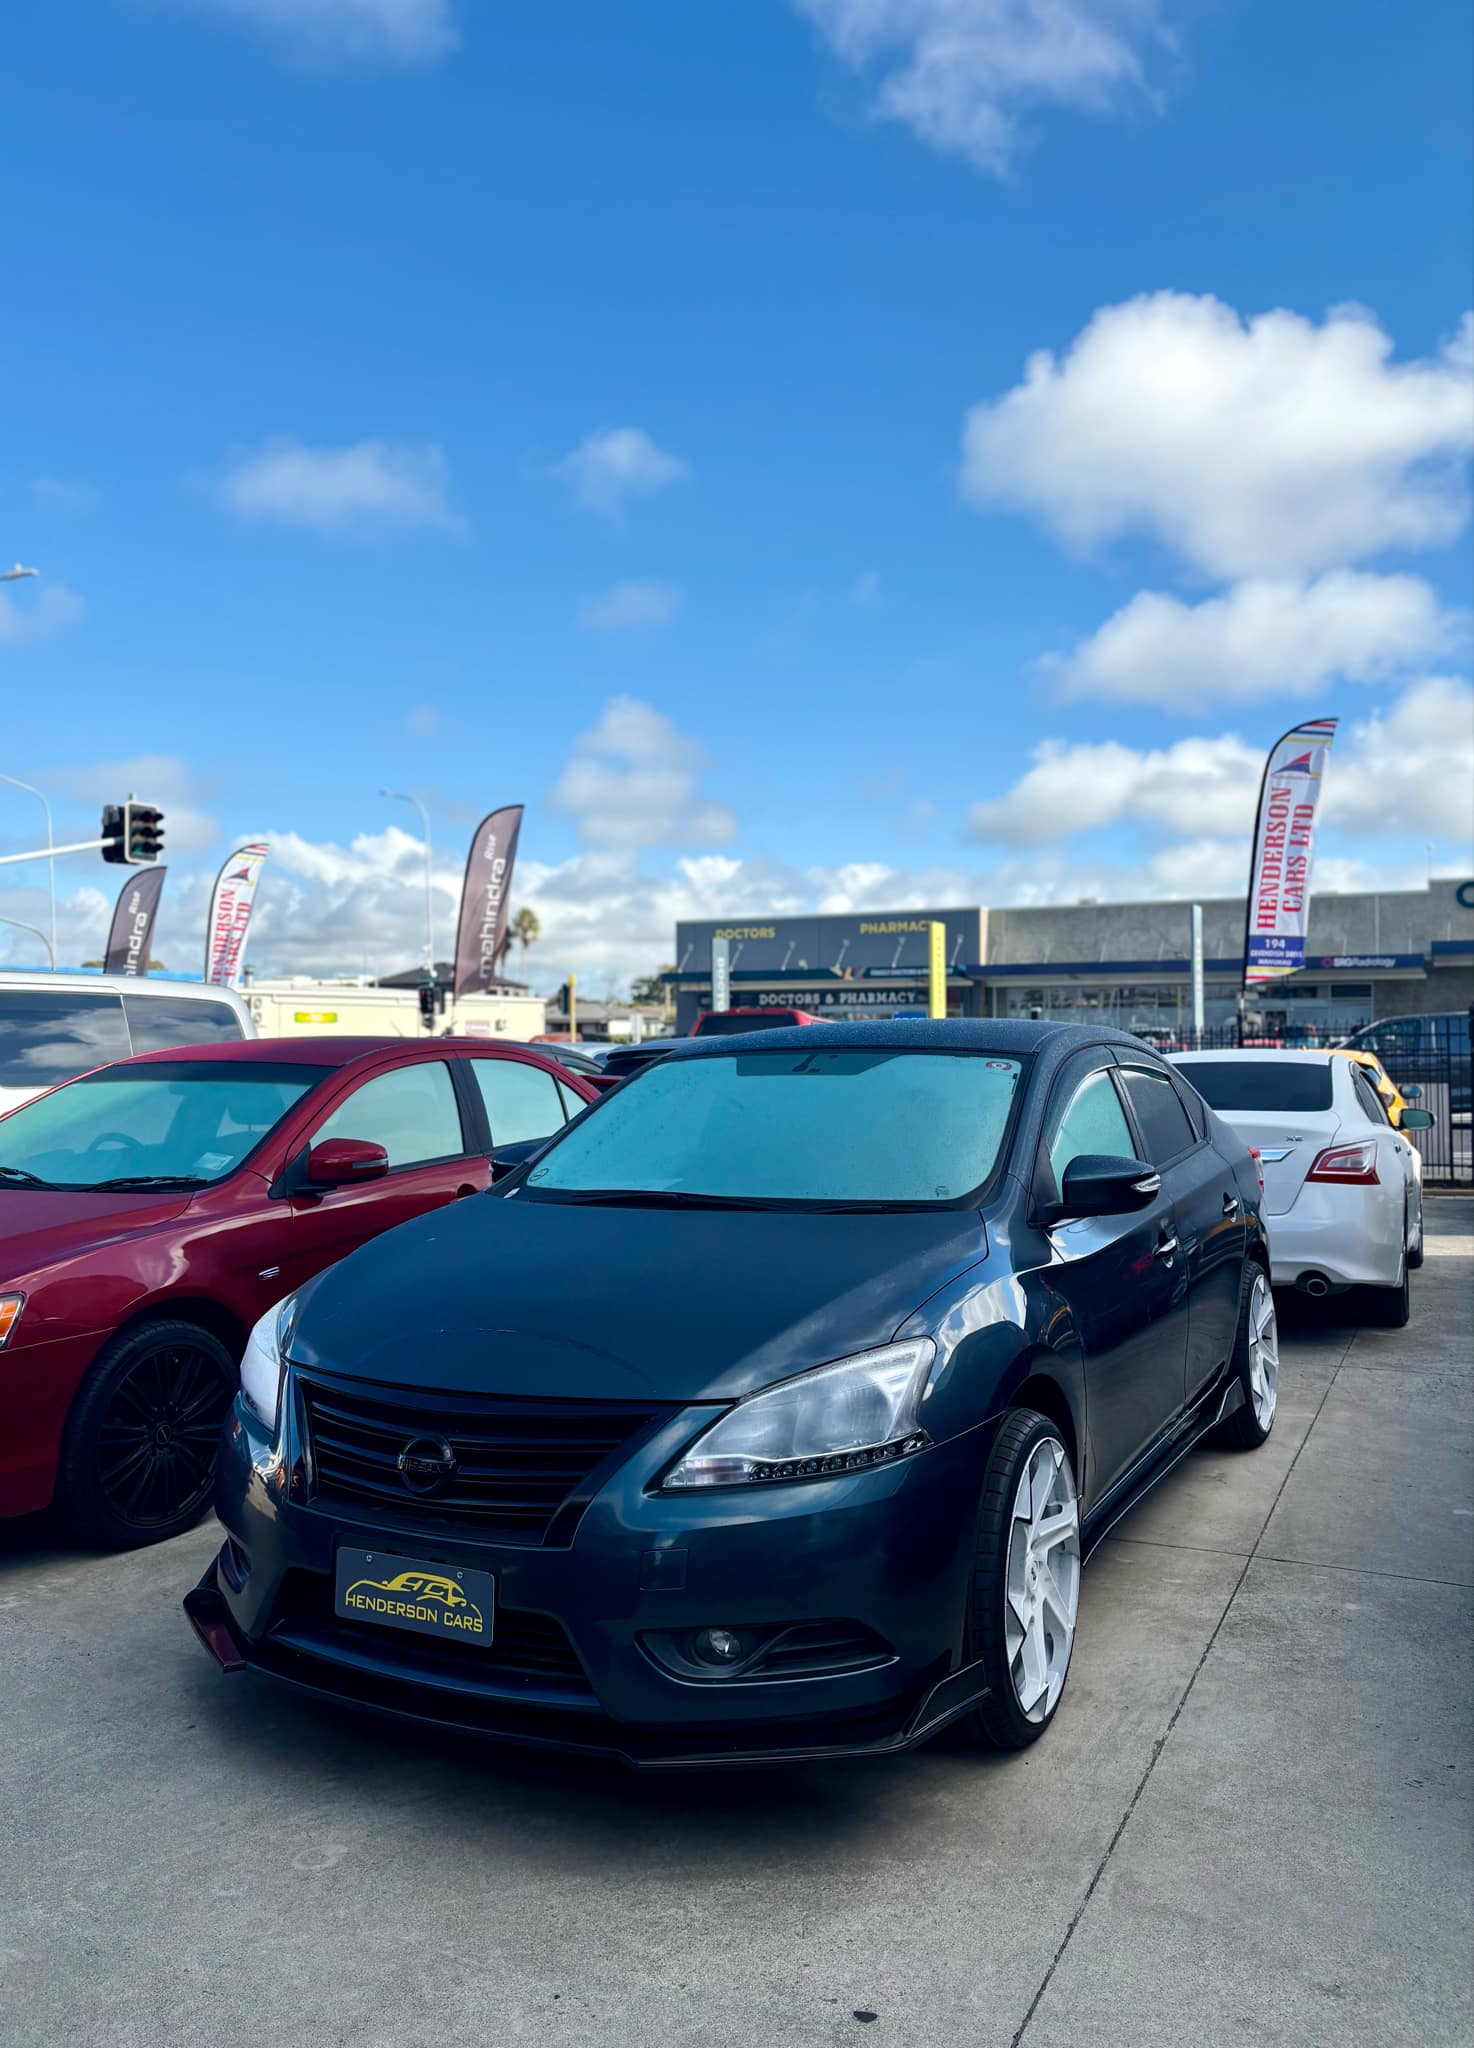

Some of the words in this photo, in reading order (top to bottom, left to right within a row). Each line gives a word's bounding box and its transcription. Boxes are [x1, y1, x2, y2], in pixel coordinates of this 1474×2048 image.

[1289, 804, 1315, 847] LTD
[1256, 786, 1292, 929] HENDERSON
[1282, 855, 1308, 913] CARS
[233, 902, 251, 933] LTD
[479, 858, 506, 979] mahindra
[715, 927, 776, 939] DOCTORS
[860, 921, 929, 934] PHARMAC
[1265, 938, 1286, 949] 194
[759, 993, 820, 1005] DOCTORS
[825, 993, 834, 1004] &
[839, 992, 916, 1004] PHARMACY
[345, 1594, 438, 1623] HENDERSON
[444, 1612, 483, 1633] CARS
